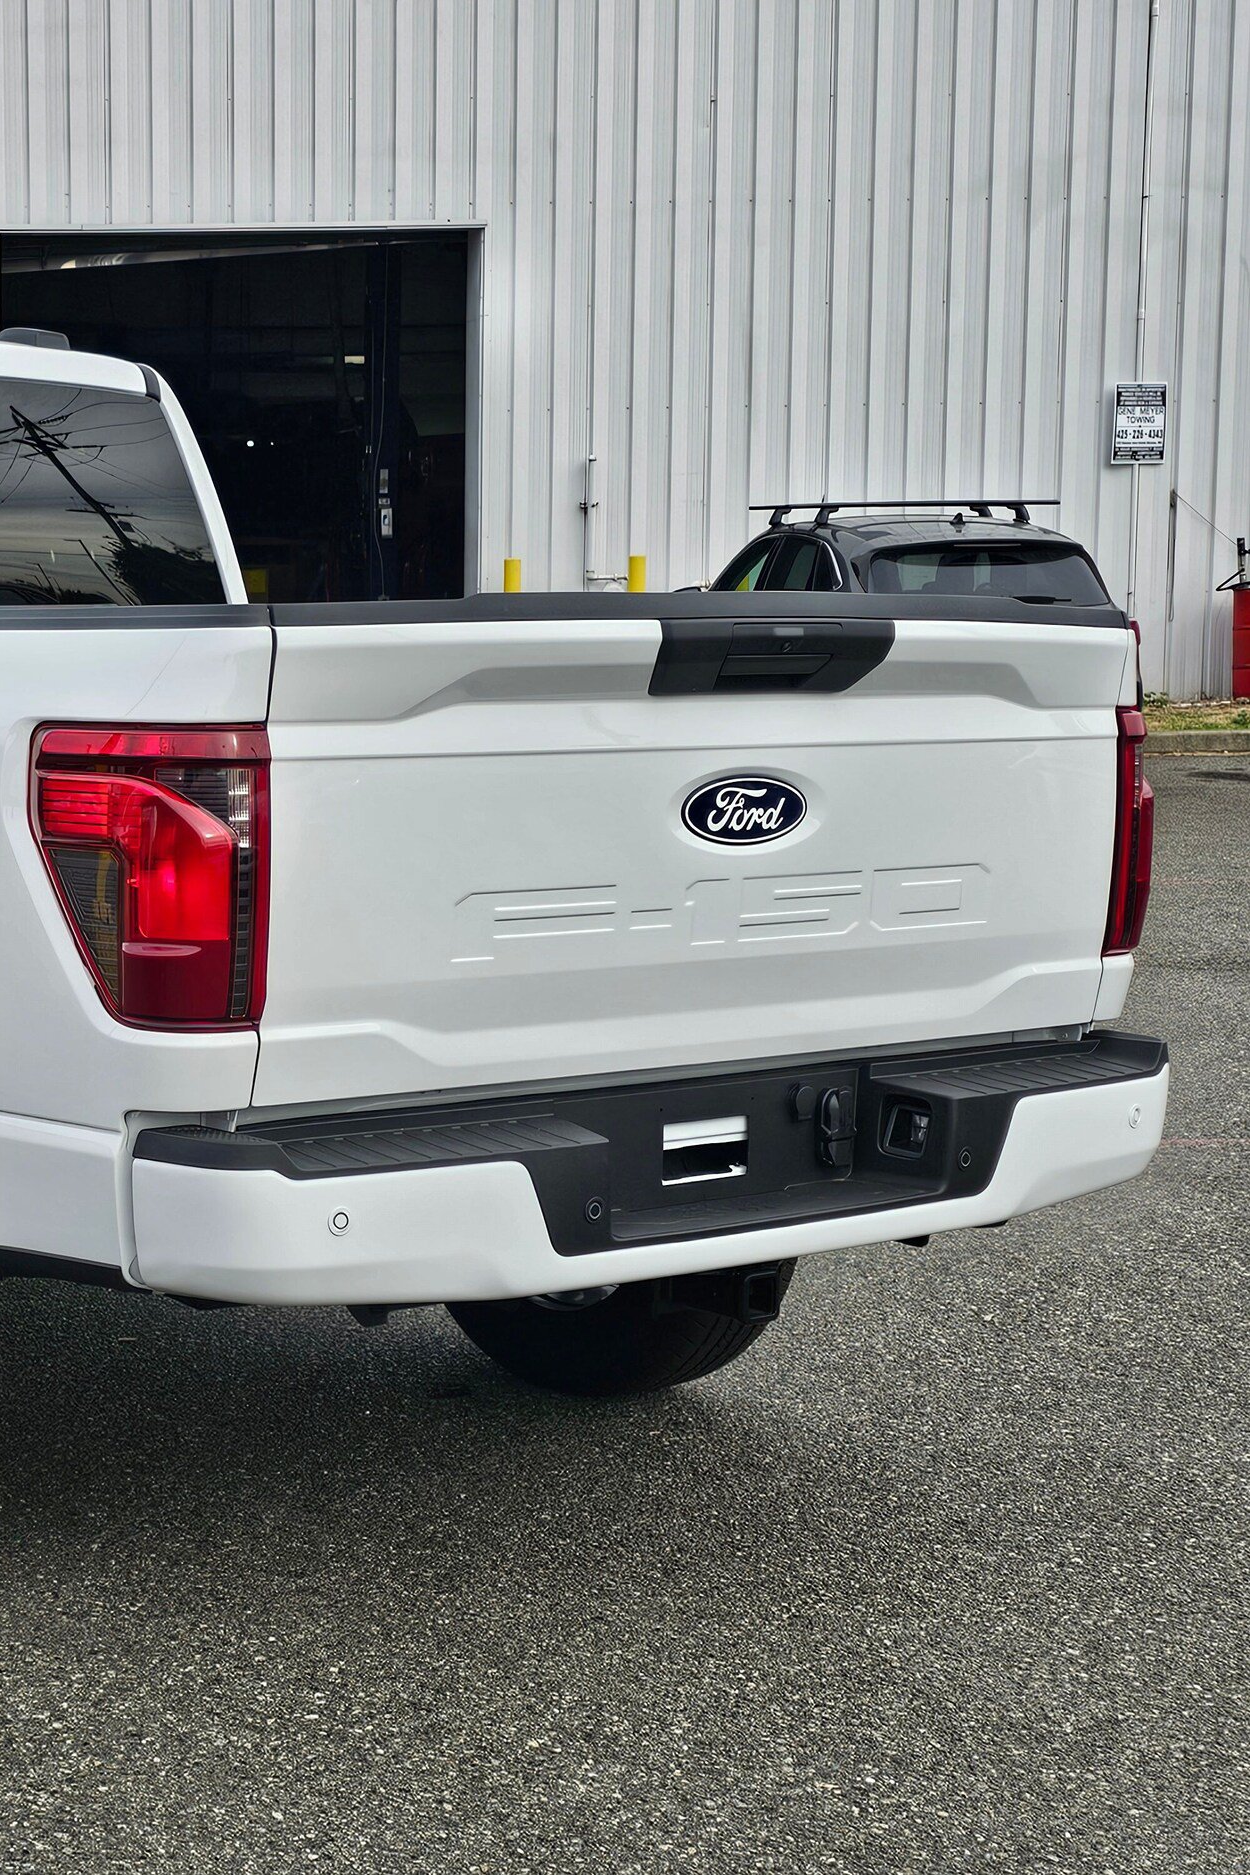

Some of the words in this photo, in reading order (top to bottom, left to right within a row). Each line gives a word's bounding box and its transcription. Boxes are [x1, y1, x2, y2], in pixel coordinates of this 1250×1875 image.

[1118, 407, 1136, 415] GENE
[1139, 407, 1165, 415] MEYER
[707, 787, 786, 832] Ford
[451, 863, 991, 962] F-150
